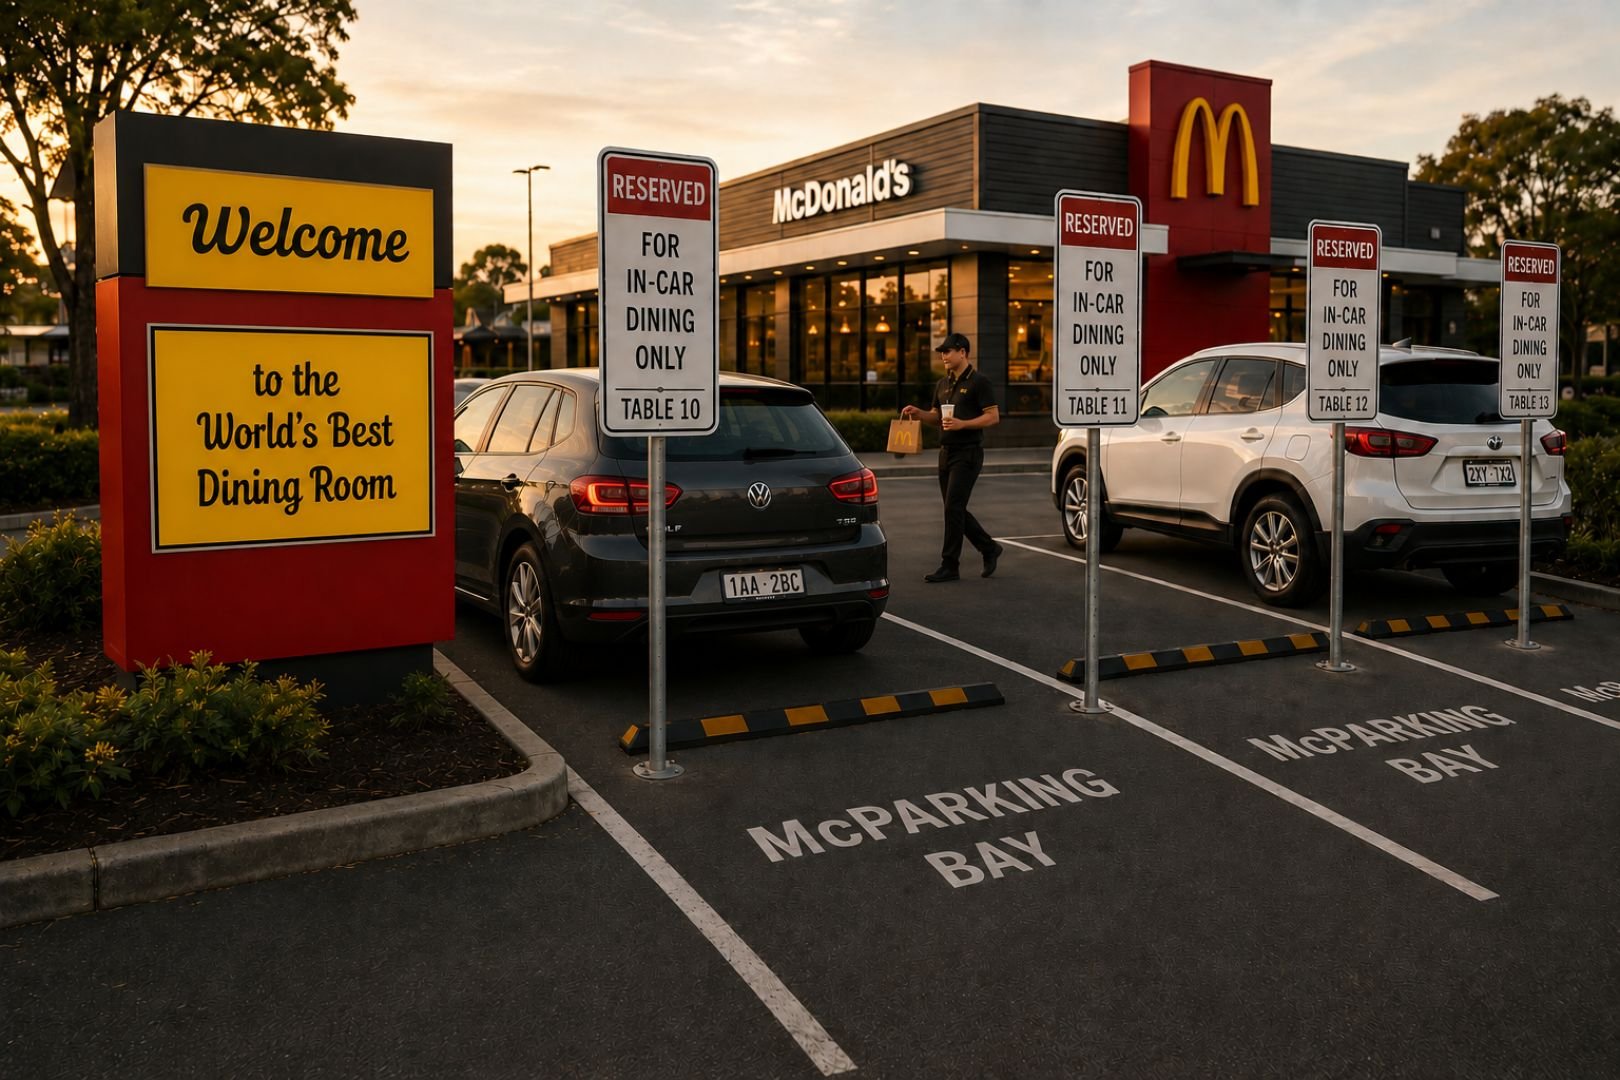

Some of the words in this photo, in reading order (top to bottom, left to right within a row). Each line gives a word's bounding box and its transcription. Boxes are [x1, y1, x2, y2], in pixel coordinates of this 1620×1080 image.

[612, 173, 706, 206] RESERVED
[772, 159, 911, 224] McDonald's
[182, 202, 410, 263] Welcome
[1065, 212, 1134, 237] RESERVED
[642, 231, 680, 259] FOR
[1316, 238, 1374, 260] RESERVED
[1085, 260, 1114, 283] FOR
[1507, 255, 1555, 275] RESERVED
[627, 268, 694, 296] IN-CAR
[1333, 278, 1358, 299] FOR
[1073, 291, 1124, 314] IN-CAR
[1521, 291, 1541, 309] FOR
[626, 306, 695, 334] DINING
[1323, 305, 1366, 325] IN-CAR
[1512, 314, 1547, 333] IN-CAR
[1073, 323, 1124, 346] DINING
[1322, 332, 1366, 352] DINING
[635, 344, 687, 371] ONLY
[1512, 338, 1547, 356] DINING
[1080, 354, 1117, 376] ONLY
[1327, 358, 1359, 378] ONLY
[1517, 362, 1542, 380] ONLY
[253, 363, 284, 397] to
[292, 361, 341, 397] the
[620, 397, 674, 420] TABLE
[680, 398, 701, 420] 10
[1068, 396, 1109, 416] TABLE
[1112, 396, 1128, 415] 11
[1318, 395, 1352, 412] TABLE
[1355, 395, 1368, 412] 12
[1508, 394, 1537, 410] TABLE
[1539, 395, 1549, 410] 13
[196, 411, 319, 451] World's
[327, 411, 395, 448] Best
[197, 468, 304, 516] Dining
[309, 465, 397, 503] Room
[1247, 705, 1517, 762] McPARKING
[1385, 744, 1499, 784] BAY
[746, 768, 1121, 863] McPARKING
[924, 831, 1057, 888] BAY
